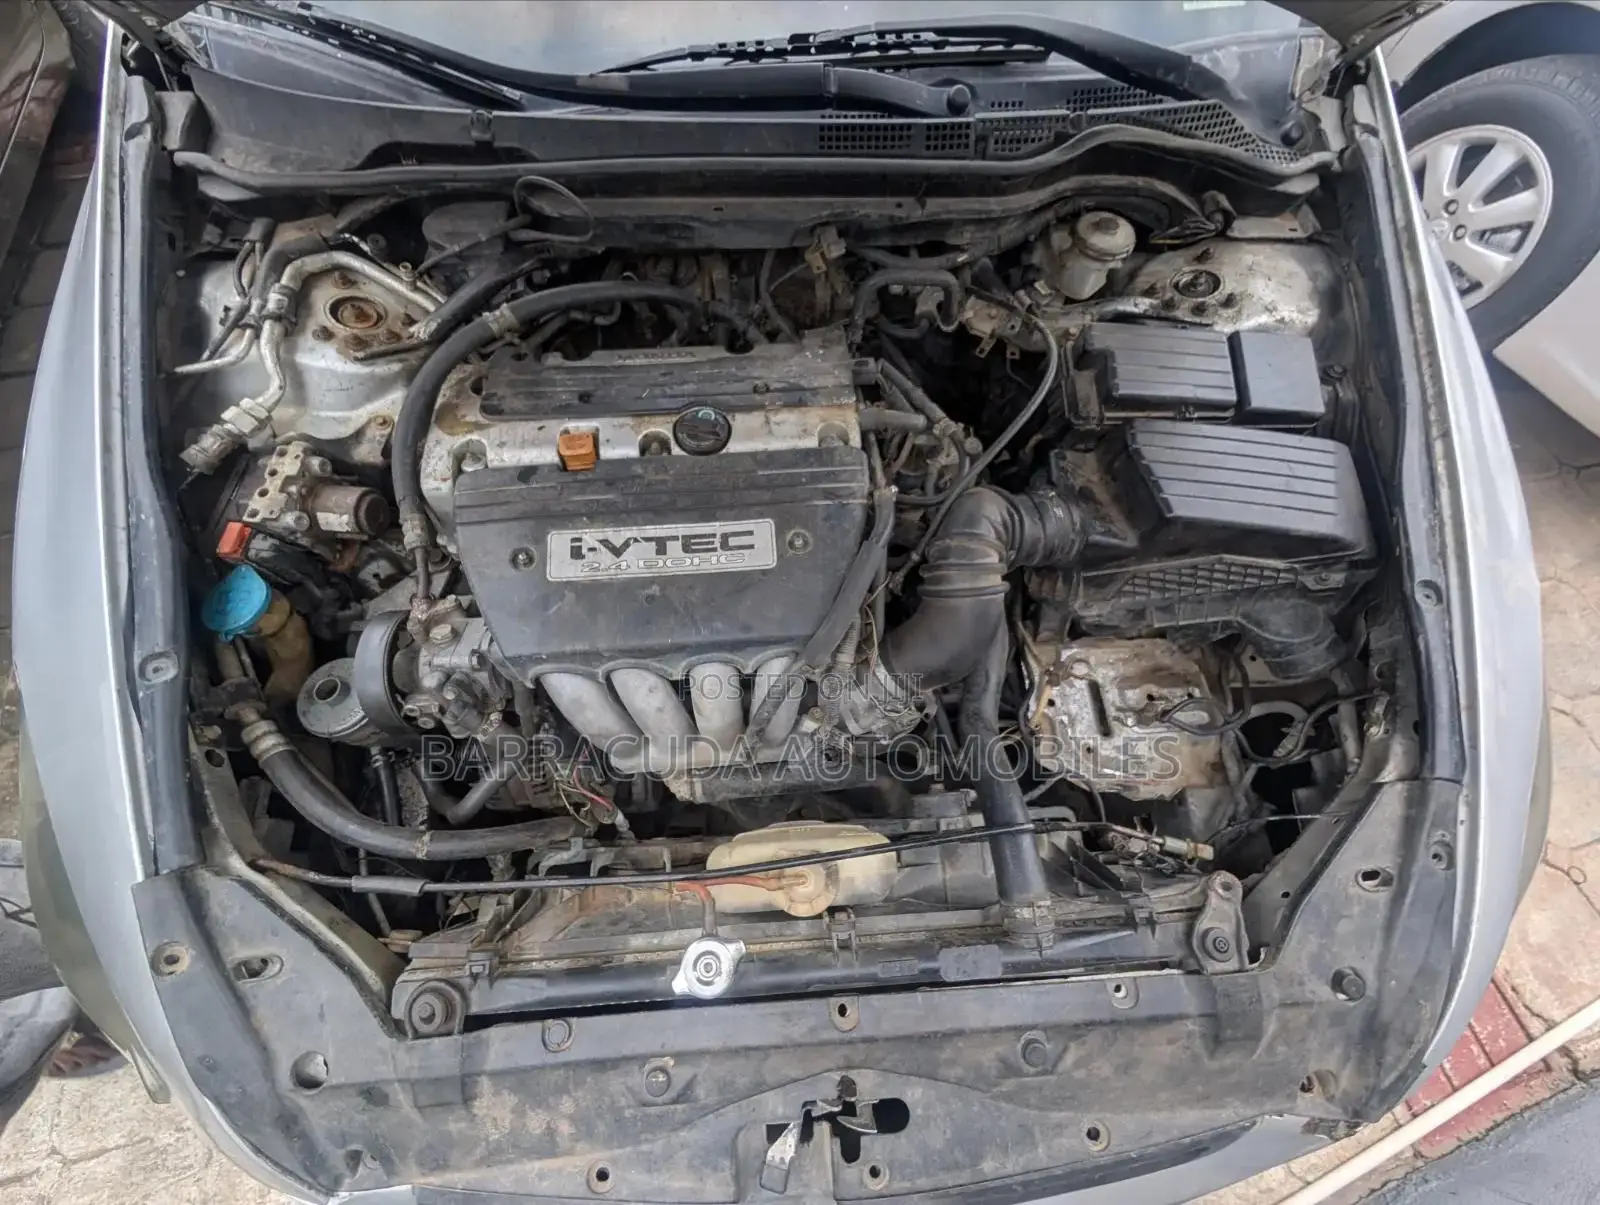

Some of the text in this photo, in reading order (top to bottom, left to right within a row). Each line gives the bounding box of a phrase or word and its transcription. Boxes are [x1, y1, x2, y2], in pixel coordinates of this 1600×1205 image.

[570, 530, 755, 560] i-VTEC
[580, 552, 746, 573] 2.4 DOHC
